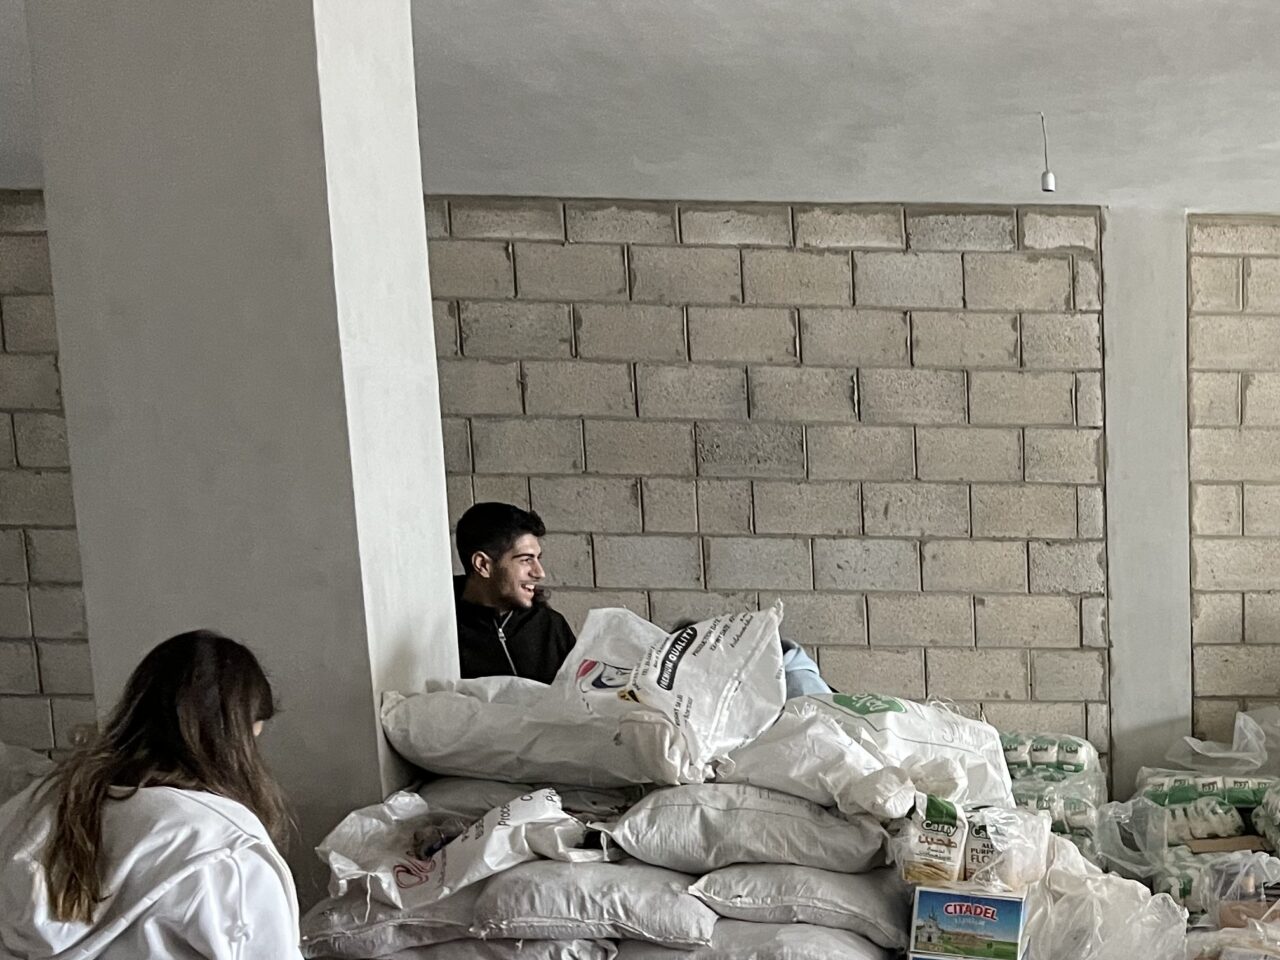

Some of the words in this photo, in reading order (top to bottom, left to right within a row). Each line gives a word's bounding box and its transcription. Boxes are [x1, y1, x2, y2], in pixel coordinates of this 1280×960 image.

[668, 626, 696, 661] QUALITY
[922, 819, 957, 838] Carry
[918, 833, 958, 849] طحين
[944, 902, 998, 922] CITADEL
